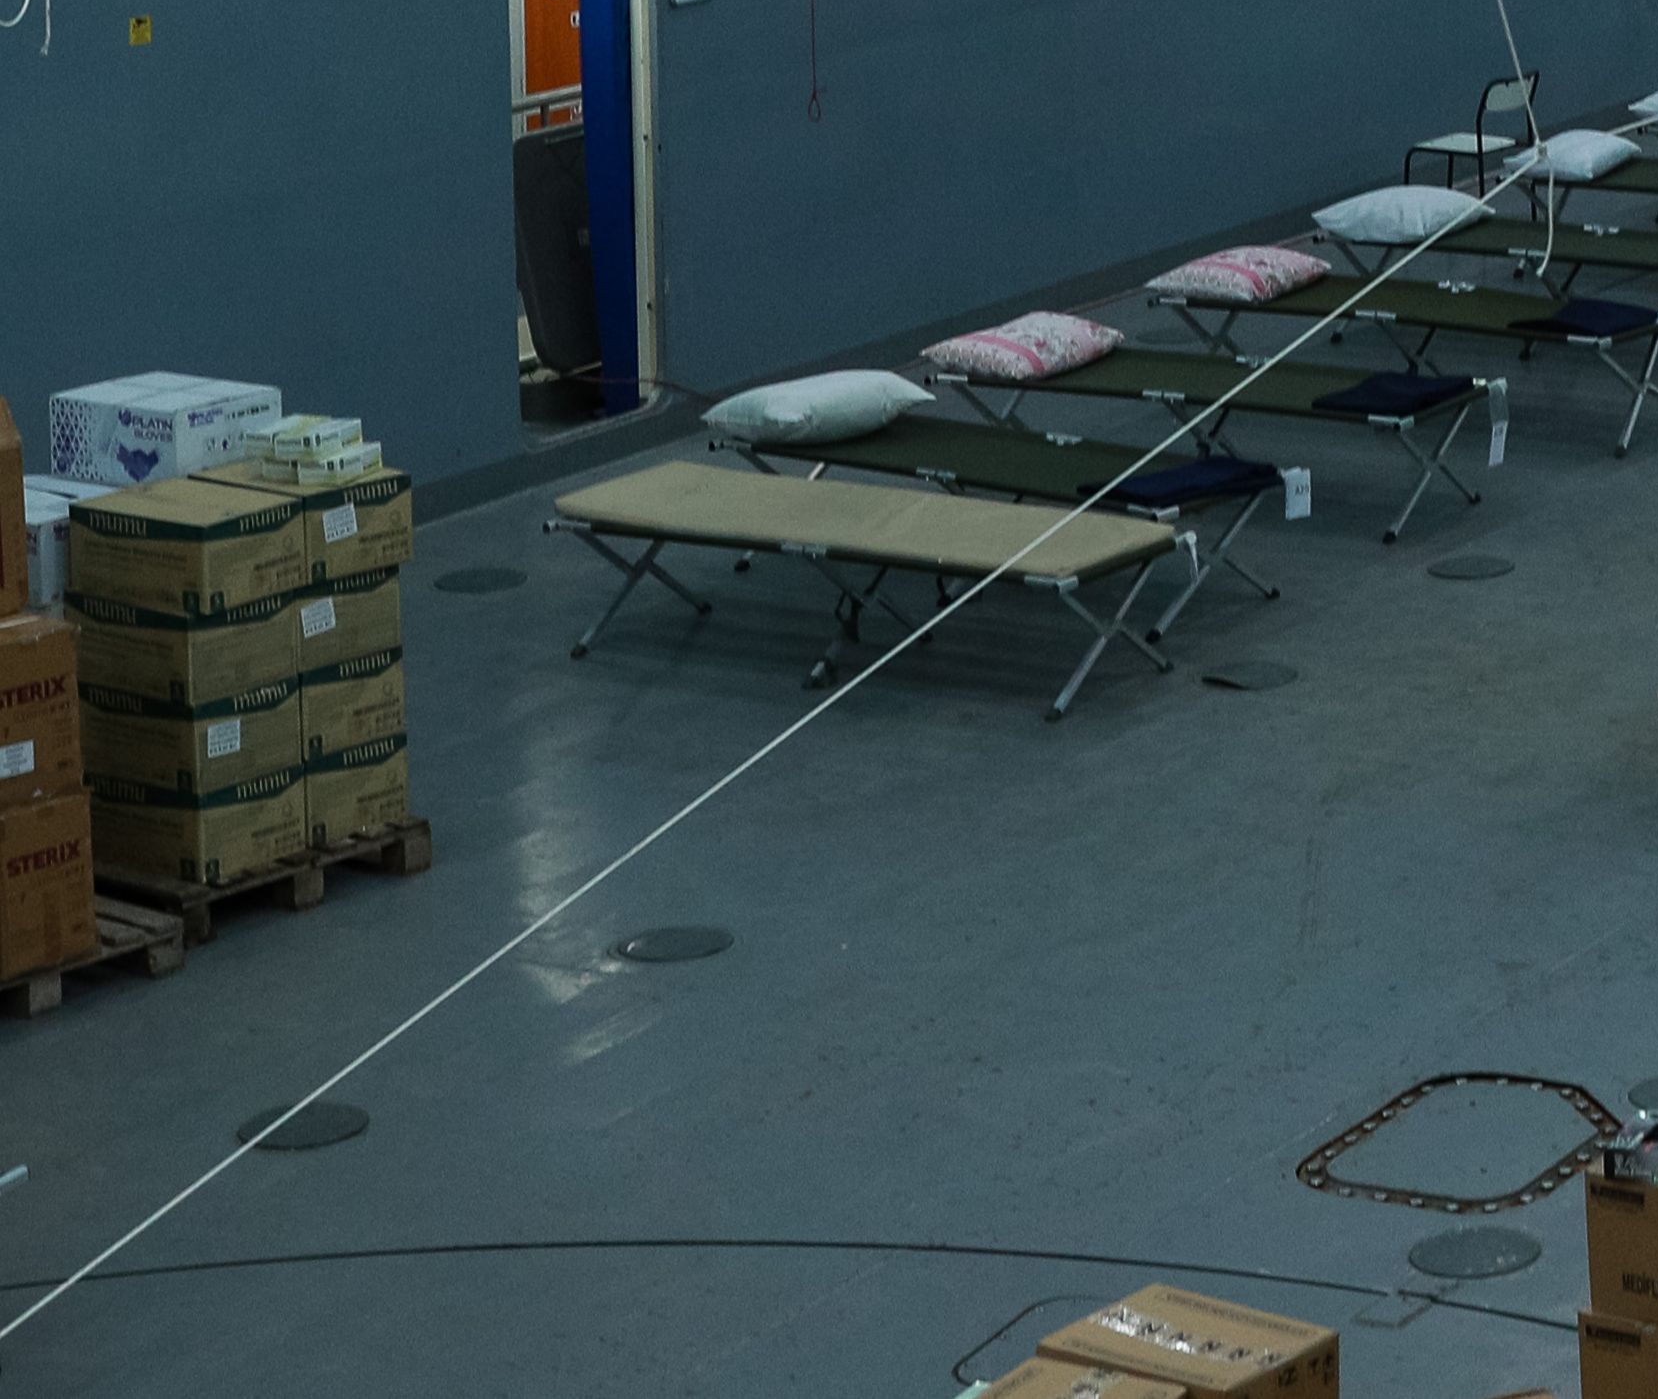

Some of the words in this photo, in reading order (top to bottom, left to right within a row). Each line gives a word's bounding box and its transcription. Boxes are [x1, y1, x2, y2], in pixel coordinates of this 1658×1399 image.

[132, 415, 174, 431] PLATIN
[344, 480, 399, 503] mumu
[87, 511, 147, 536] mumu
[239, 504, 291, 530] mumu
[83, 598, 137, 624] mumu
[226, 596, 282, 623] mumu
[339, 652, 391, 677] mumu
[233, 682, 288, 712] mumu
[343, 739, 394, 766] mumu
[236, 771, 290, 799] mumu
[7, 839, 81, 876] STERIX
